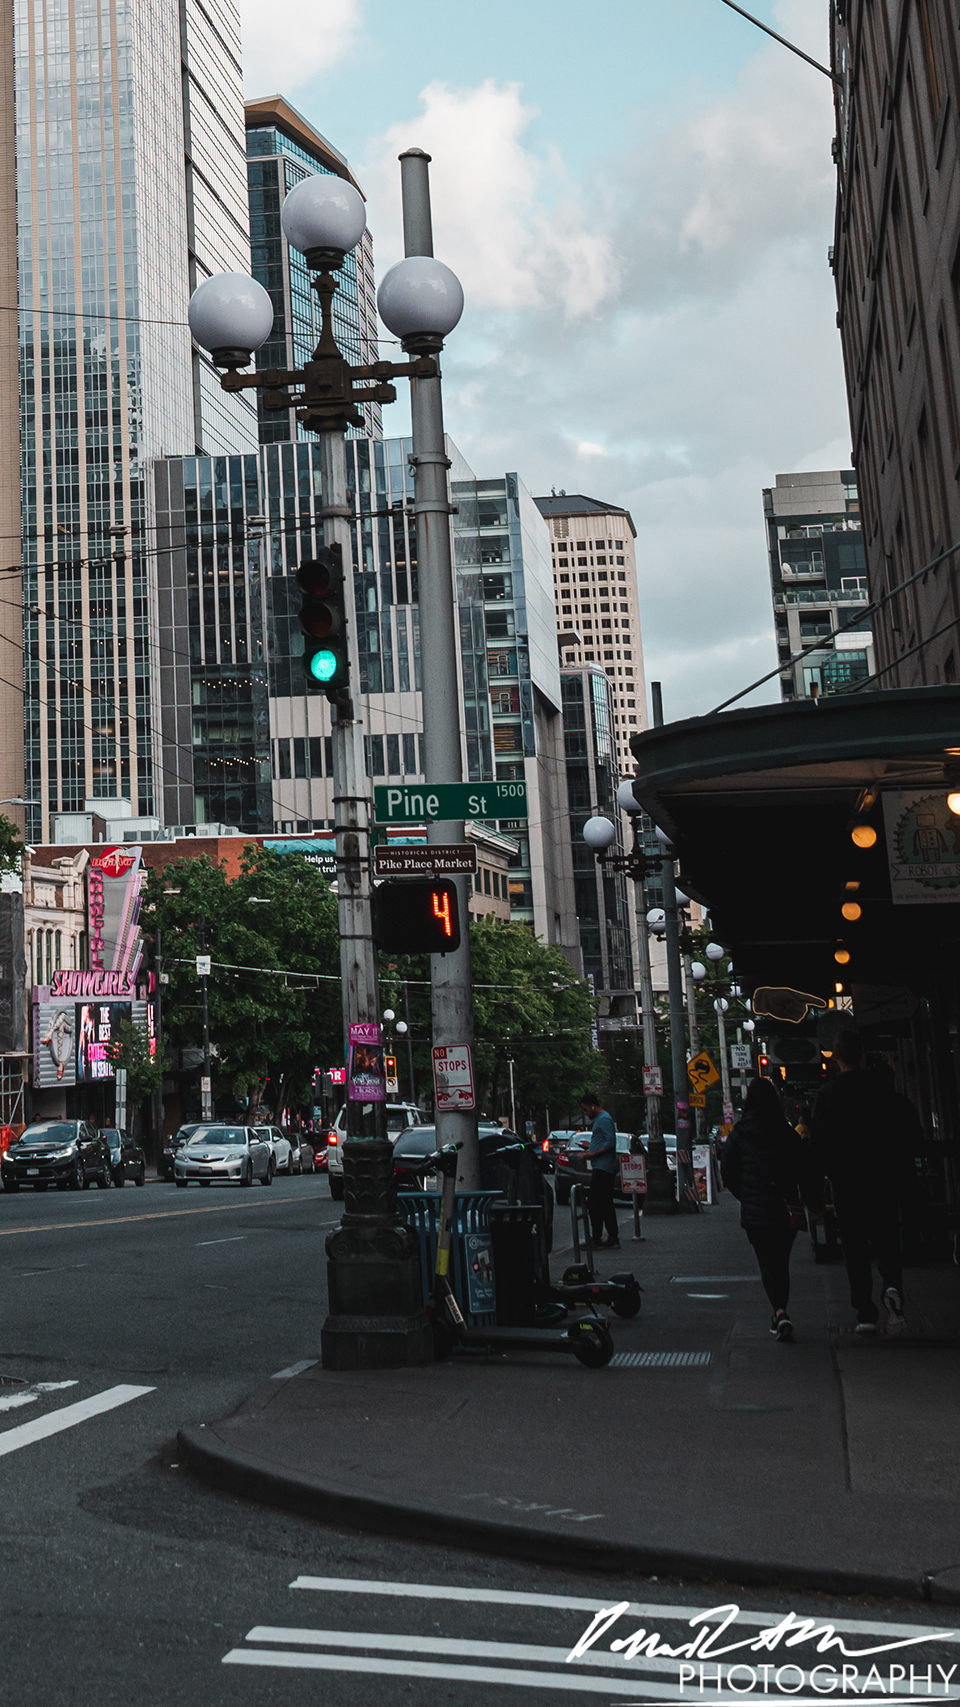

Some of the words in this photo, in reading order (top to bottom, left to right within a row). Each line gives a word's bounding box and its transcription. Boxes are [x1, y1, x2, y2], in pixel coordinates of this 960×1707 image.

[496, 784, 525, 797] 1500
[387, 789, 439, 817] Pine
[468, 795, 487, 814] St
[304, 855, 323, 864] Help
[378, 859, 402, 869] Pike
[403, 859, 432, 869] Place
[434, 858, 473, 868] Market
[908, 865, 938, 877] ROBOT
[432, 891, 452, 937] 4
[89, 870, 104, 972] SHOWGIRLS
[51, 970, 135, 996] SHOWGIRLS
[99, 1007, 110, 1023] THE
[98, 1024, 111, 1041] BEST
[350, 1027, 370, 1035] MAY
[434, 1048, 445, 1058] NO
[438, 1060, 467, 1072] STOPS
